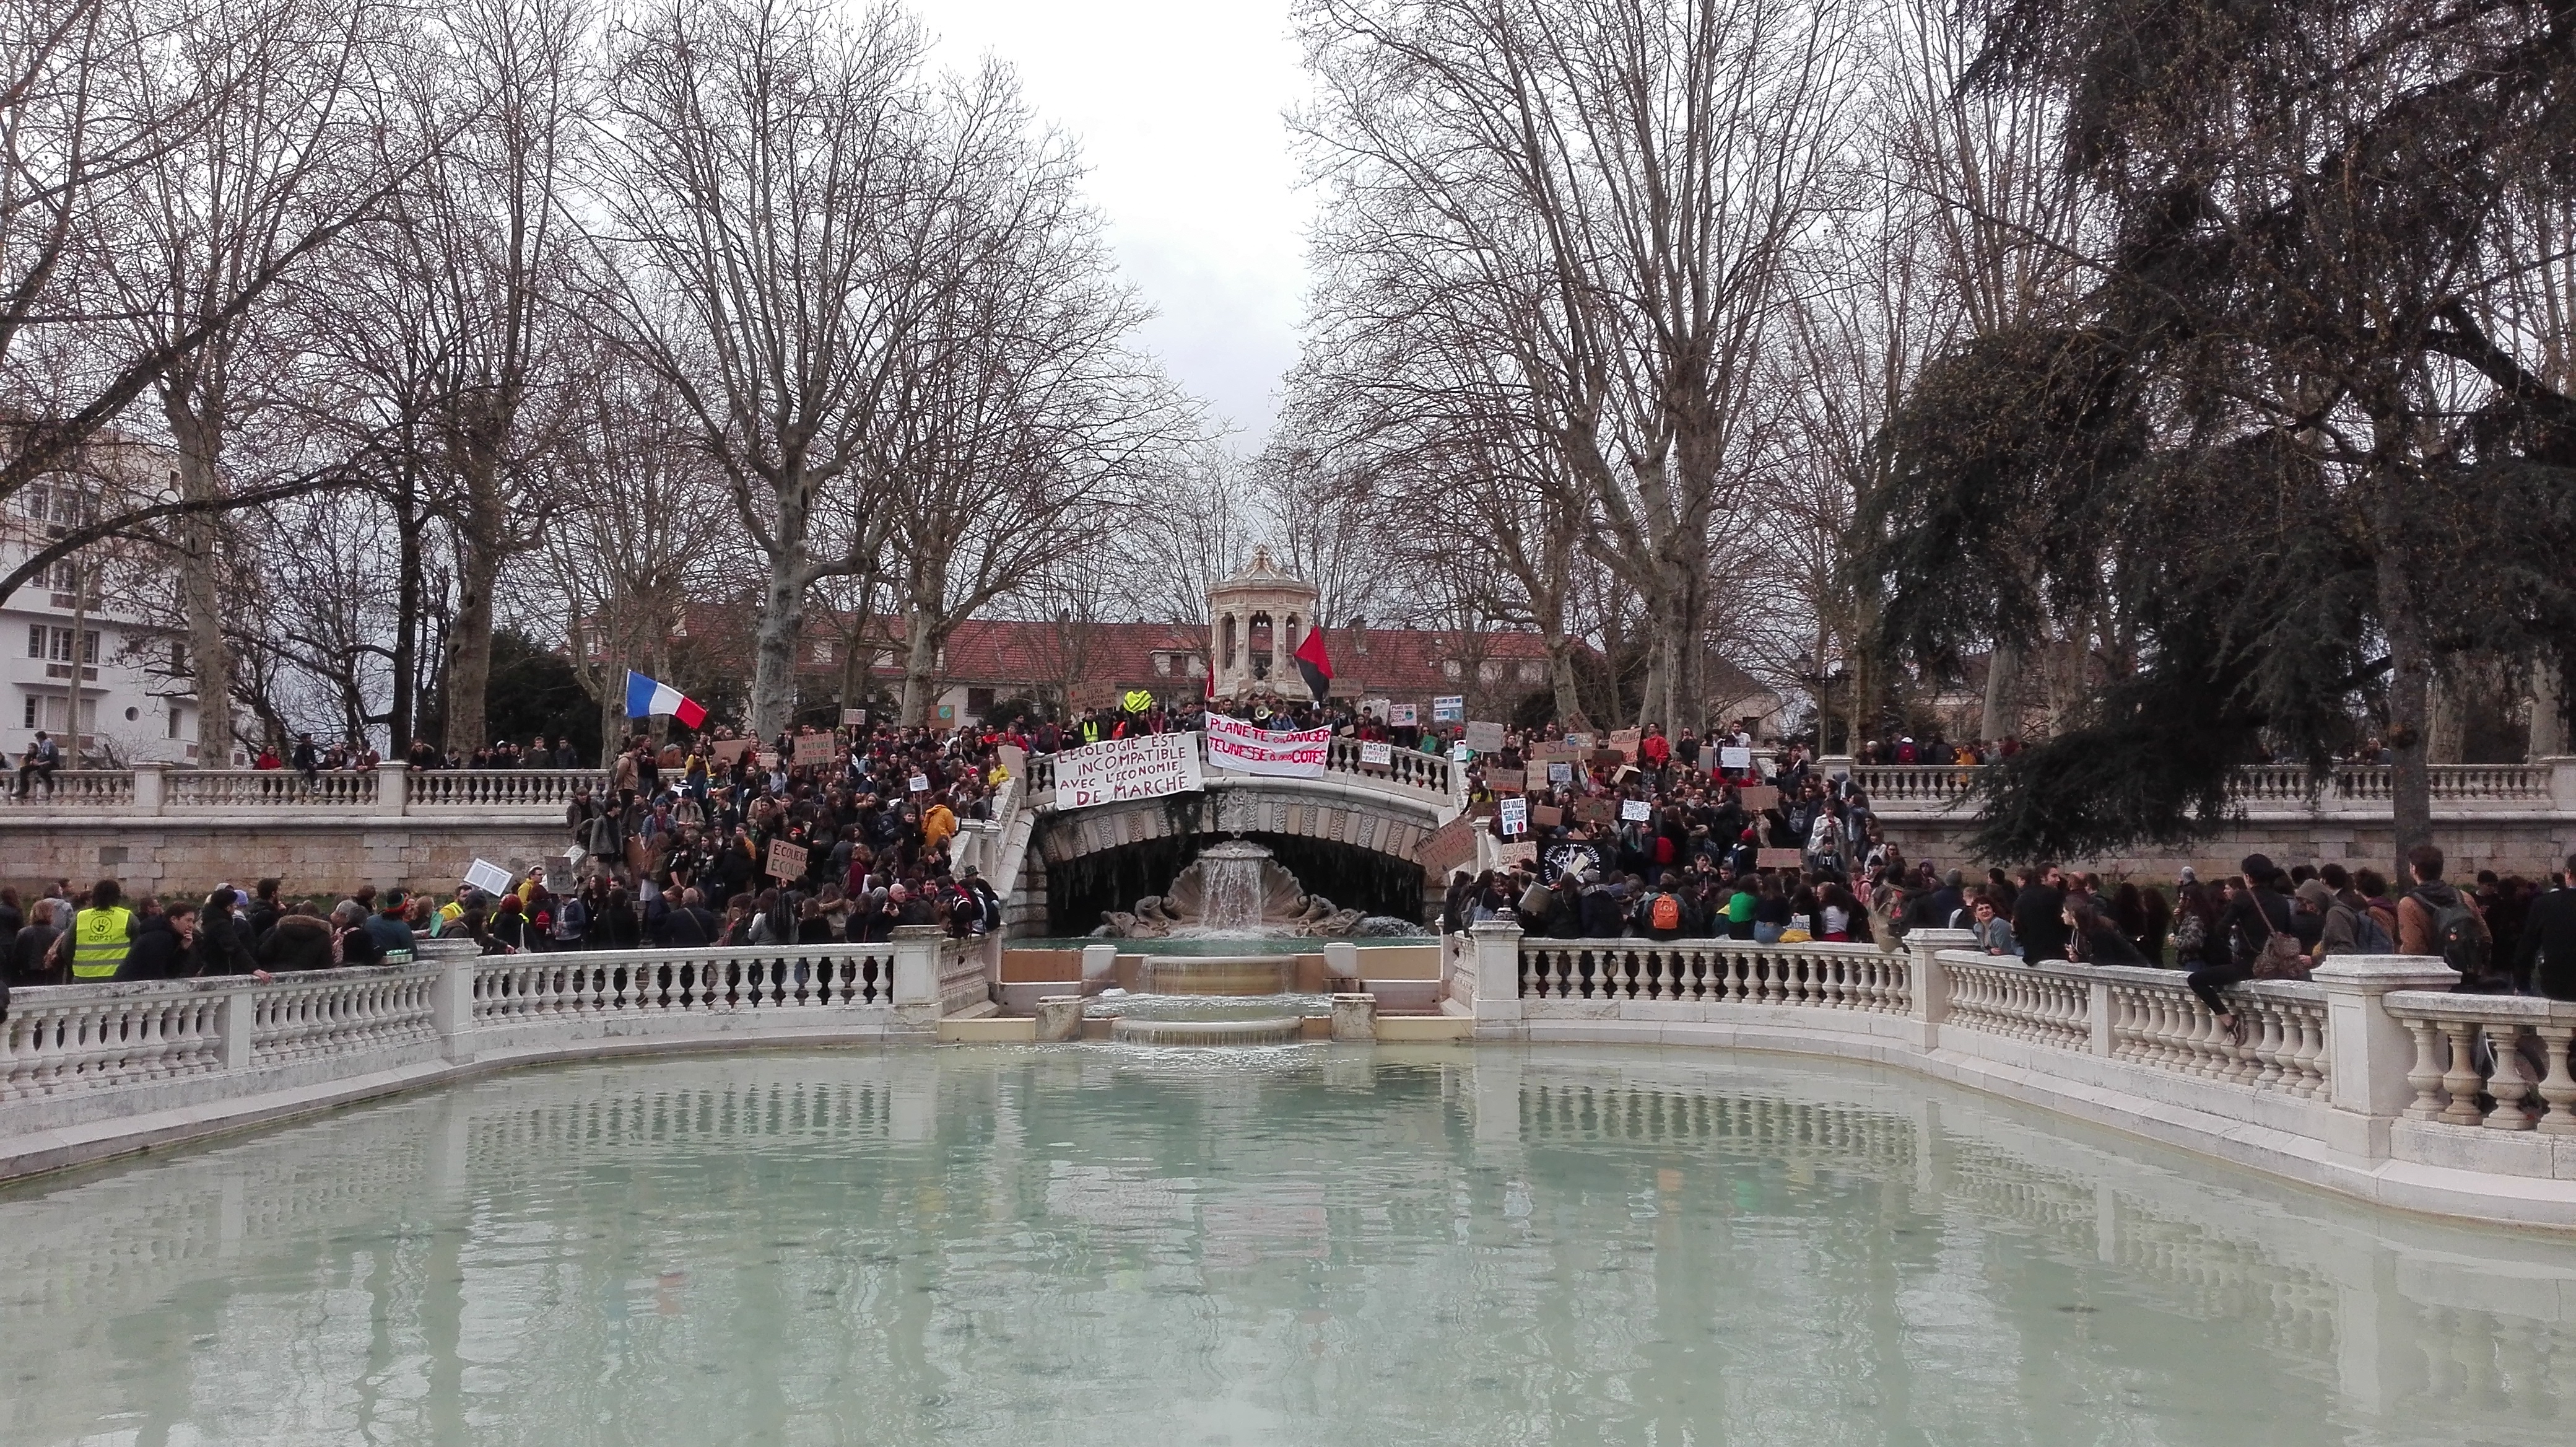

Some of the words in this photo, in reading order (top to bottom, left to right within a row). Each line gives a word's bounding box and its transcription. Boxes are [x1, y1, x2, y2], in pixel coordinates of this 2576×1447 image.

[1152, 735, 1177, 747] EST
[1286, 729, 1329, 742] DANGER
[1078, 747, 1186, 776] INCOMPATIBLE
[1060, 778, 1095, 790] AVEC
[1076, 790, 1101, 805] DE
[1114, 770, 1188, 799] MARCHÉ
